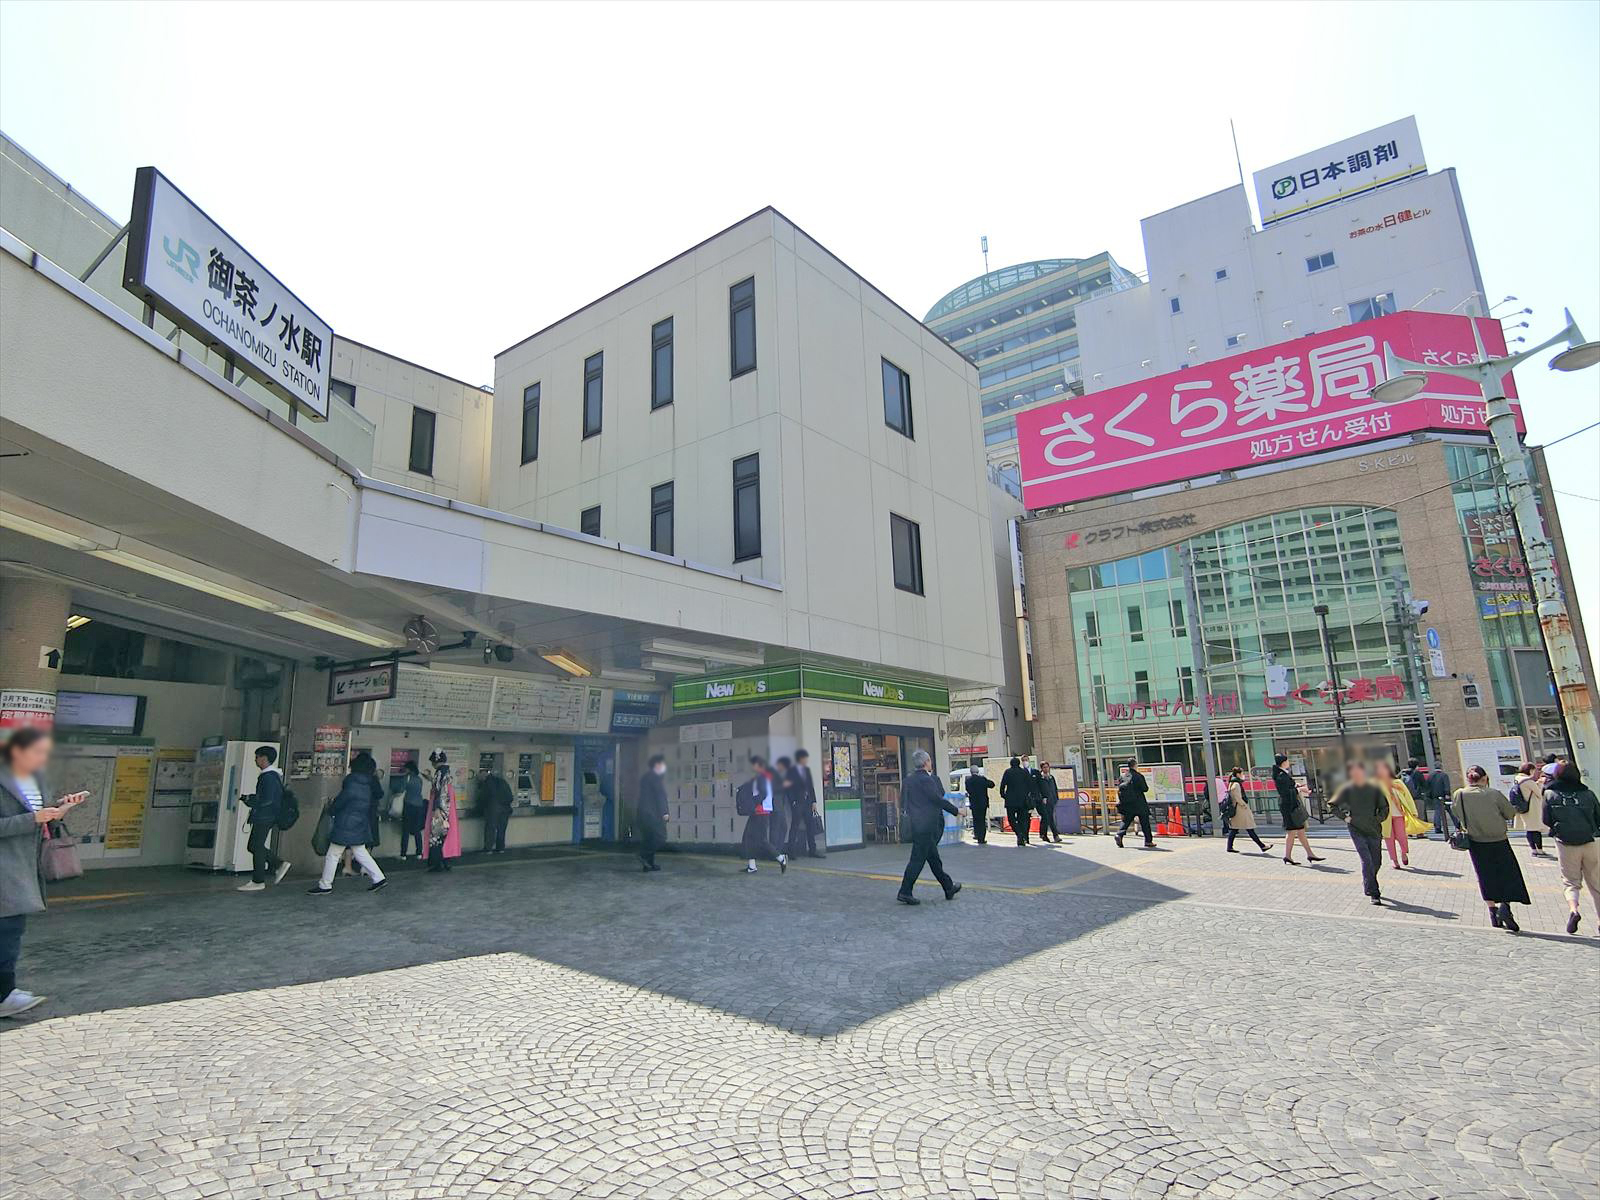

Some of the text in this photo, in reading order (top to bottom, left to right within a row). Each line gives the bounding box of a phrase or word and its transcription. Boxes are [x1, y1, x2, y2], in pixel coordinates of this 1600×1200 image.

[1300, 140, 1398, 190] 日本調剤
[1349, 208, 1431, 239] お茶の水日健ビル
[163, 235, 201, 281] JR
[207, 247, 323, 373] 御茶ノ水駅
[202, 299, 320, 401] OCHANOMIZU STATION
[1039, 335, 1378, 467] さくら薬局
[1250, 411, 1392, 460] 処方せん受付
[1084, 513, 1197, 546] クラフト株式会社
[706, 680, 766, 698] NewDays
[863, 680, 904, 700] NewDays
